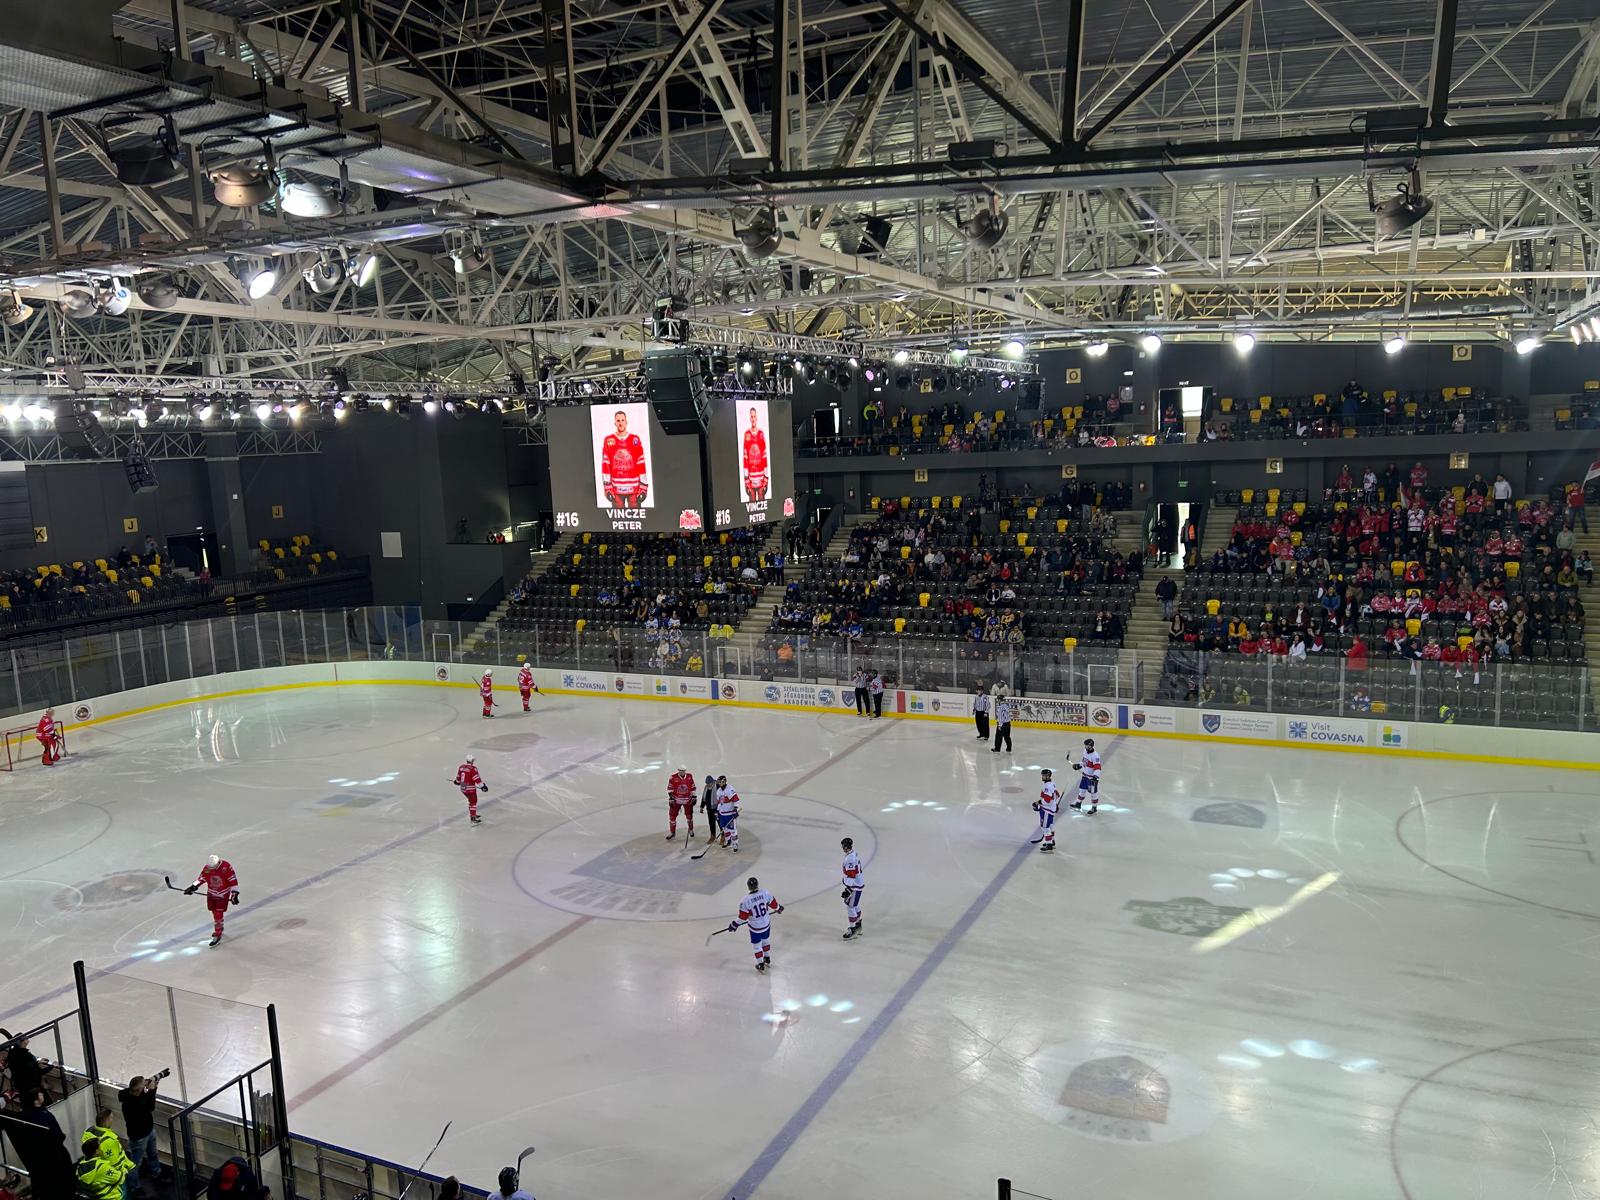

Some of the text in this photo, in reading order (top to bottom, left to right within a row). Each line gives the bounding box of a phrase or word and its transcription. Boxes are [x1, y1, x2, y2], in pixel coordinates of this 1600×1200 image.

[1069, 370, 1079, 380] O
[917, 471, 925, 480] H
[1065, 465, 1074, 476] G
[746, 501, 768, 512] VINCZE
[606, 508, 646, 519] VINCZE
[716, 509, 730, 525] #16
[749, 513, 766, 523] PETER
[556, 512, 579, 527] #16
[612, 521, 642, 530] PETER
[575, 682, 606, 691] COVASNA
[783, 692, 816, 700] JÉGKORONG
[1311, 722, 1331, 731] Visit
[1311, 732, 1365, 744] COVASNA
[754, 902, 767, 918] 16
